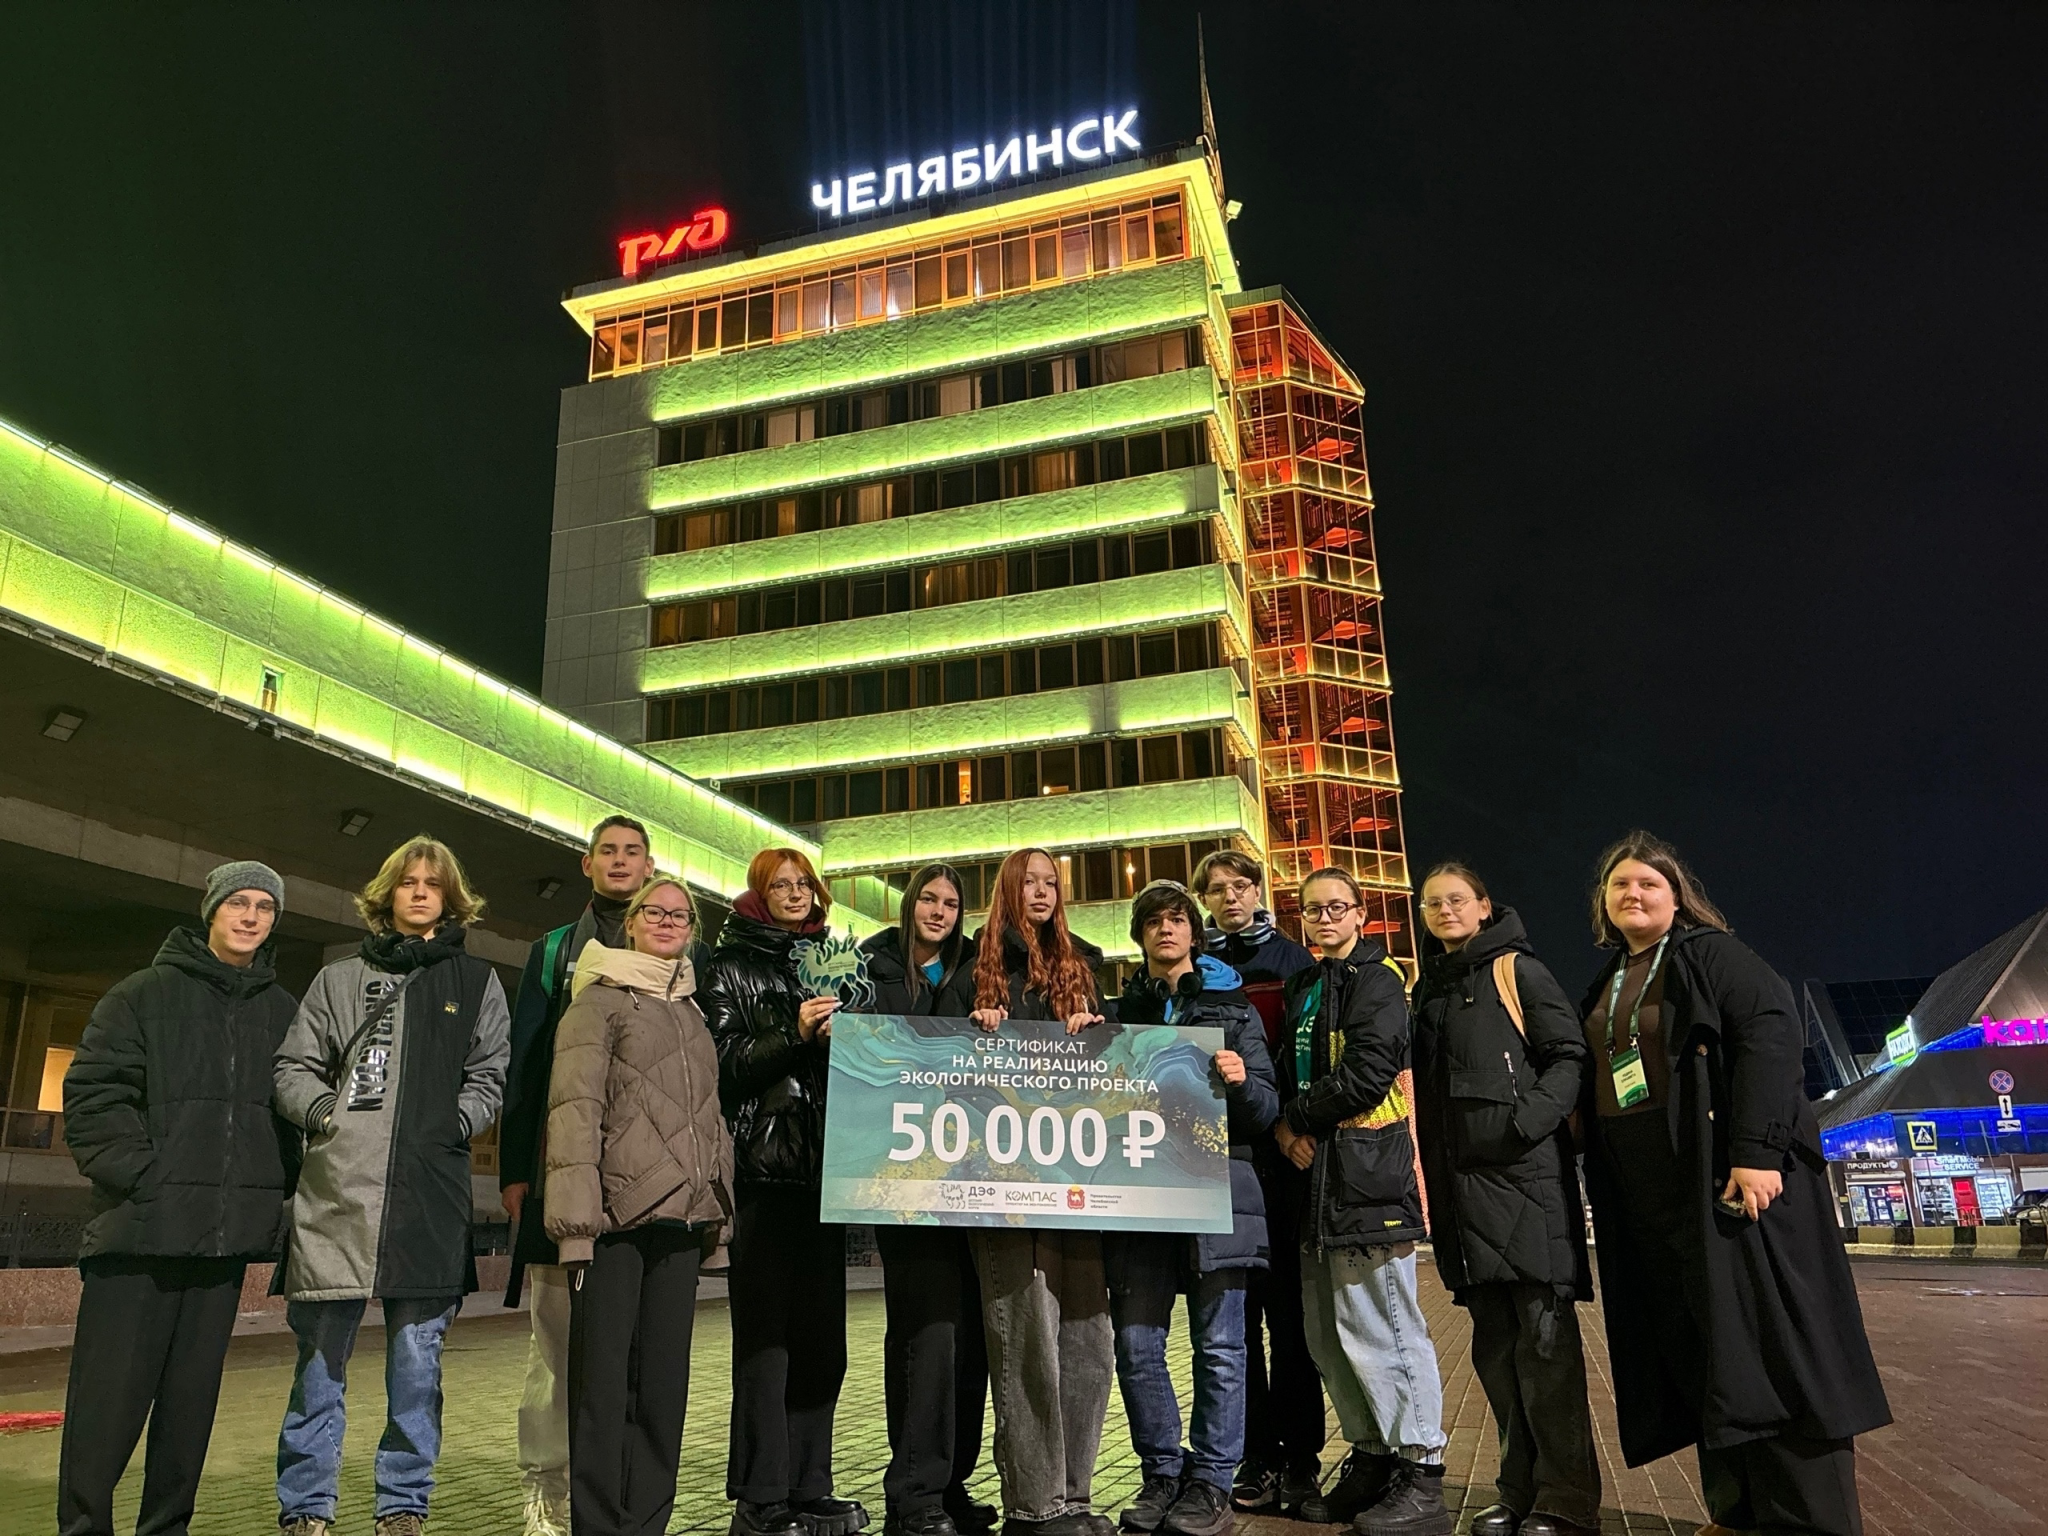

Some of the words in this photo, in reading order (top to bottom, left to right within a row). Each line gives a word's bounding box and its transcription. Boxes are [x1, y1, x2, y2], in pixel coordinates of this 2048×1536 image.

[811, 109, 1142, 218] ЧЕЛЯБИНСК
[974, 1037, 1087, 1055] СЕРТИФИКАТ
[952, 1055, 977, 1069] НА
[983, 1056, 1108, 1075] РЕАЛИЗАЦИЮ
[899, 1071, 1071, 1090] ЭКОЛОГИЧЕСКОГО
[1077, 1076, 1159, 1093] ПРОЕКТА
[887, 1102, 970, 1163] 50
[985, 1104, 1108, 1167] 000
[1122, 1110, 1166, 1168] ₽
[1846, 1161, 1889, 1170] ПРОДУКТЫ
[1936, 1155, 1959, 1164] Smart
[1960, 1155, 1984, 1163] Mobile
[1944, 1162, 1980, 1171] SERVICE
[968, 1186, 996, 1197] ДЭФ
[1005, 1189, 1057, 1203] КОМПАС
